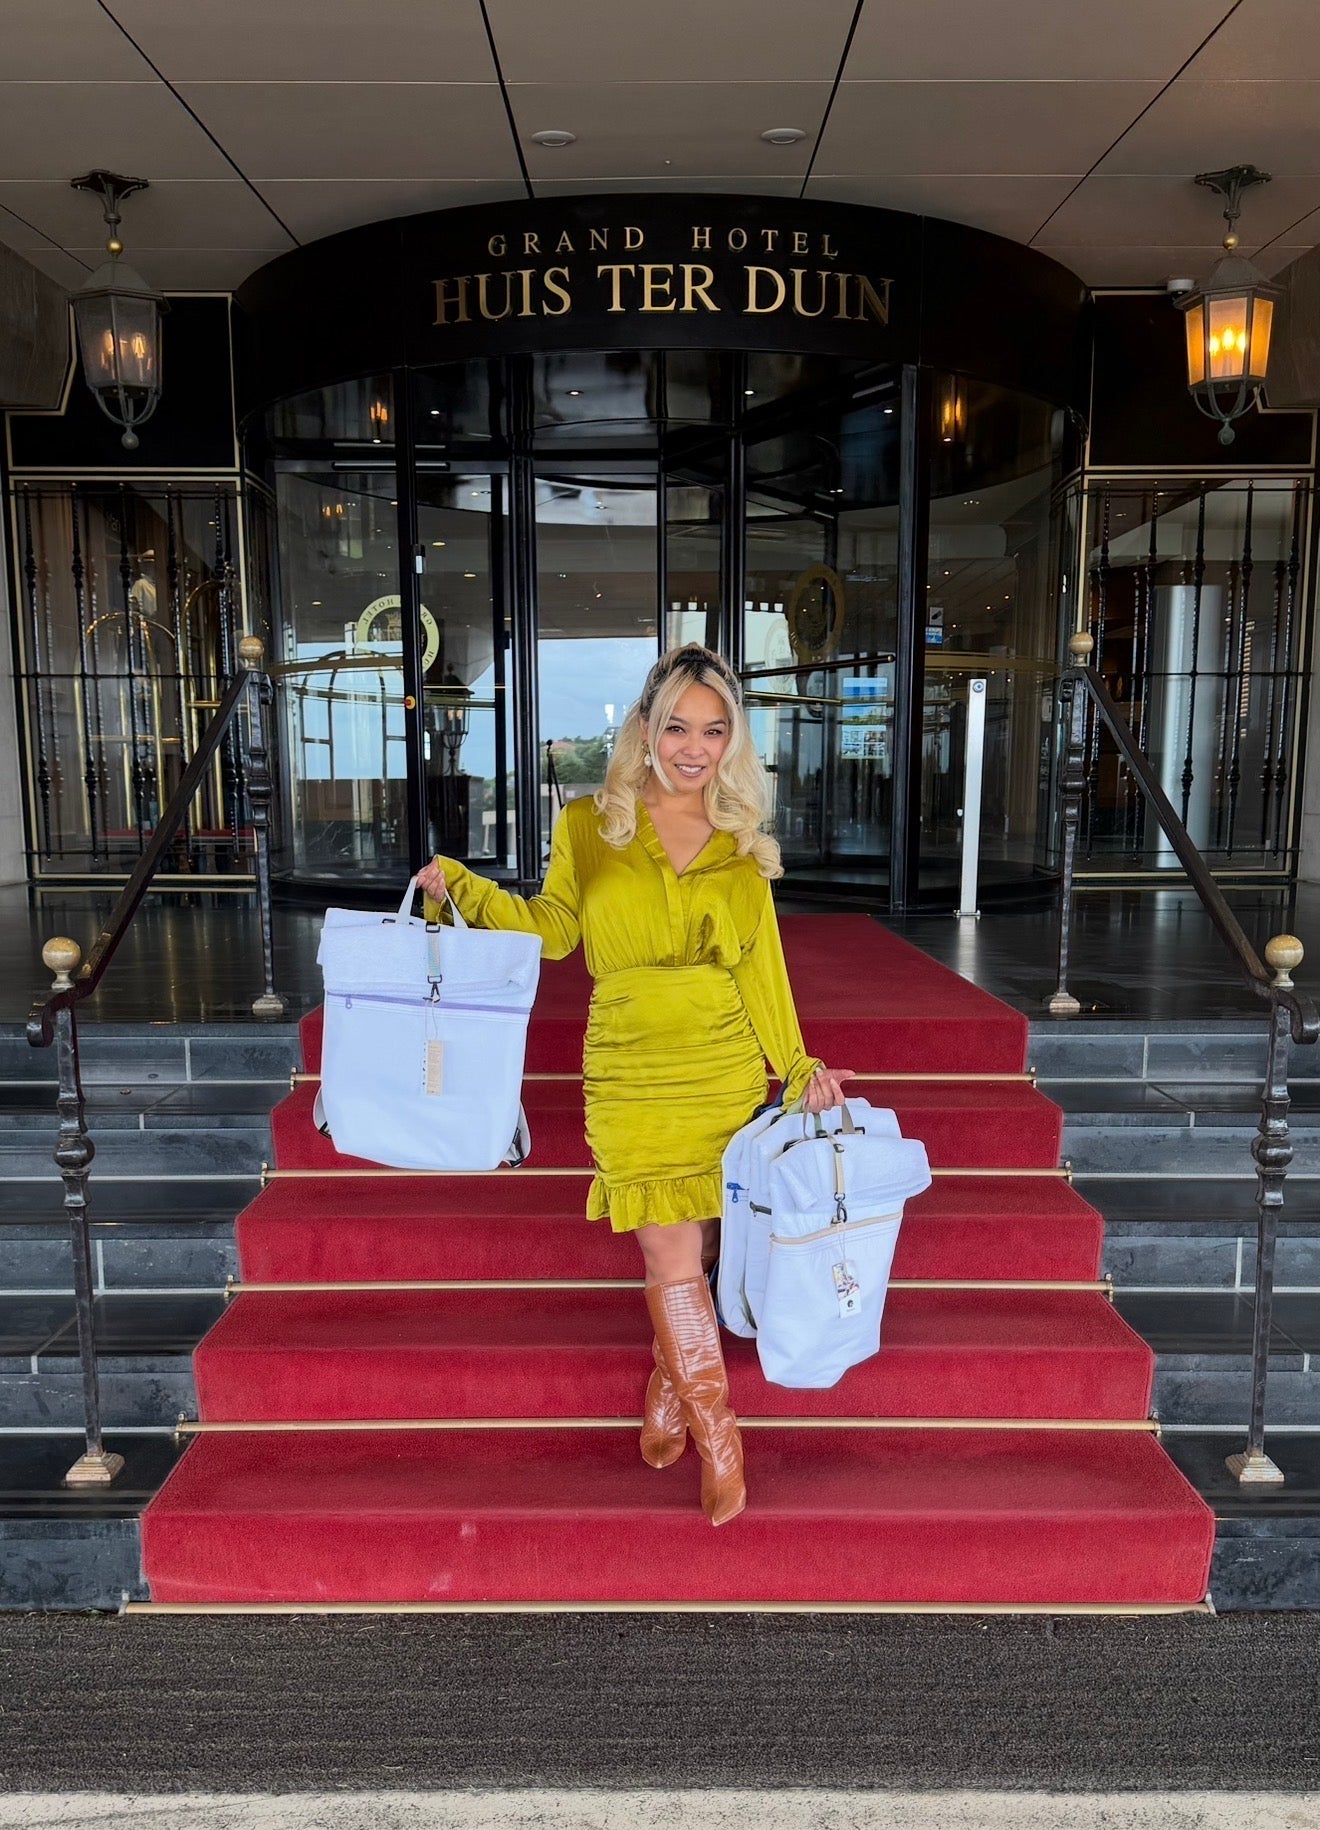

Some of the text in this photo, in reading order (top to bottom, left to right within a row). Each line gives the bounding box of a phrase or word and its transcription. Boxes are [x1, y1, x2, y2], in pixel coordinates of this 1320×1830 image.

[488, 226, 839, 259] GRAND HOTEL
[431, 263, 896, 327] HUIS TER DUIN
